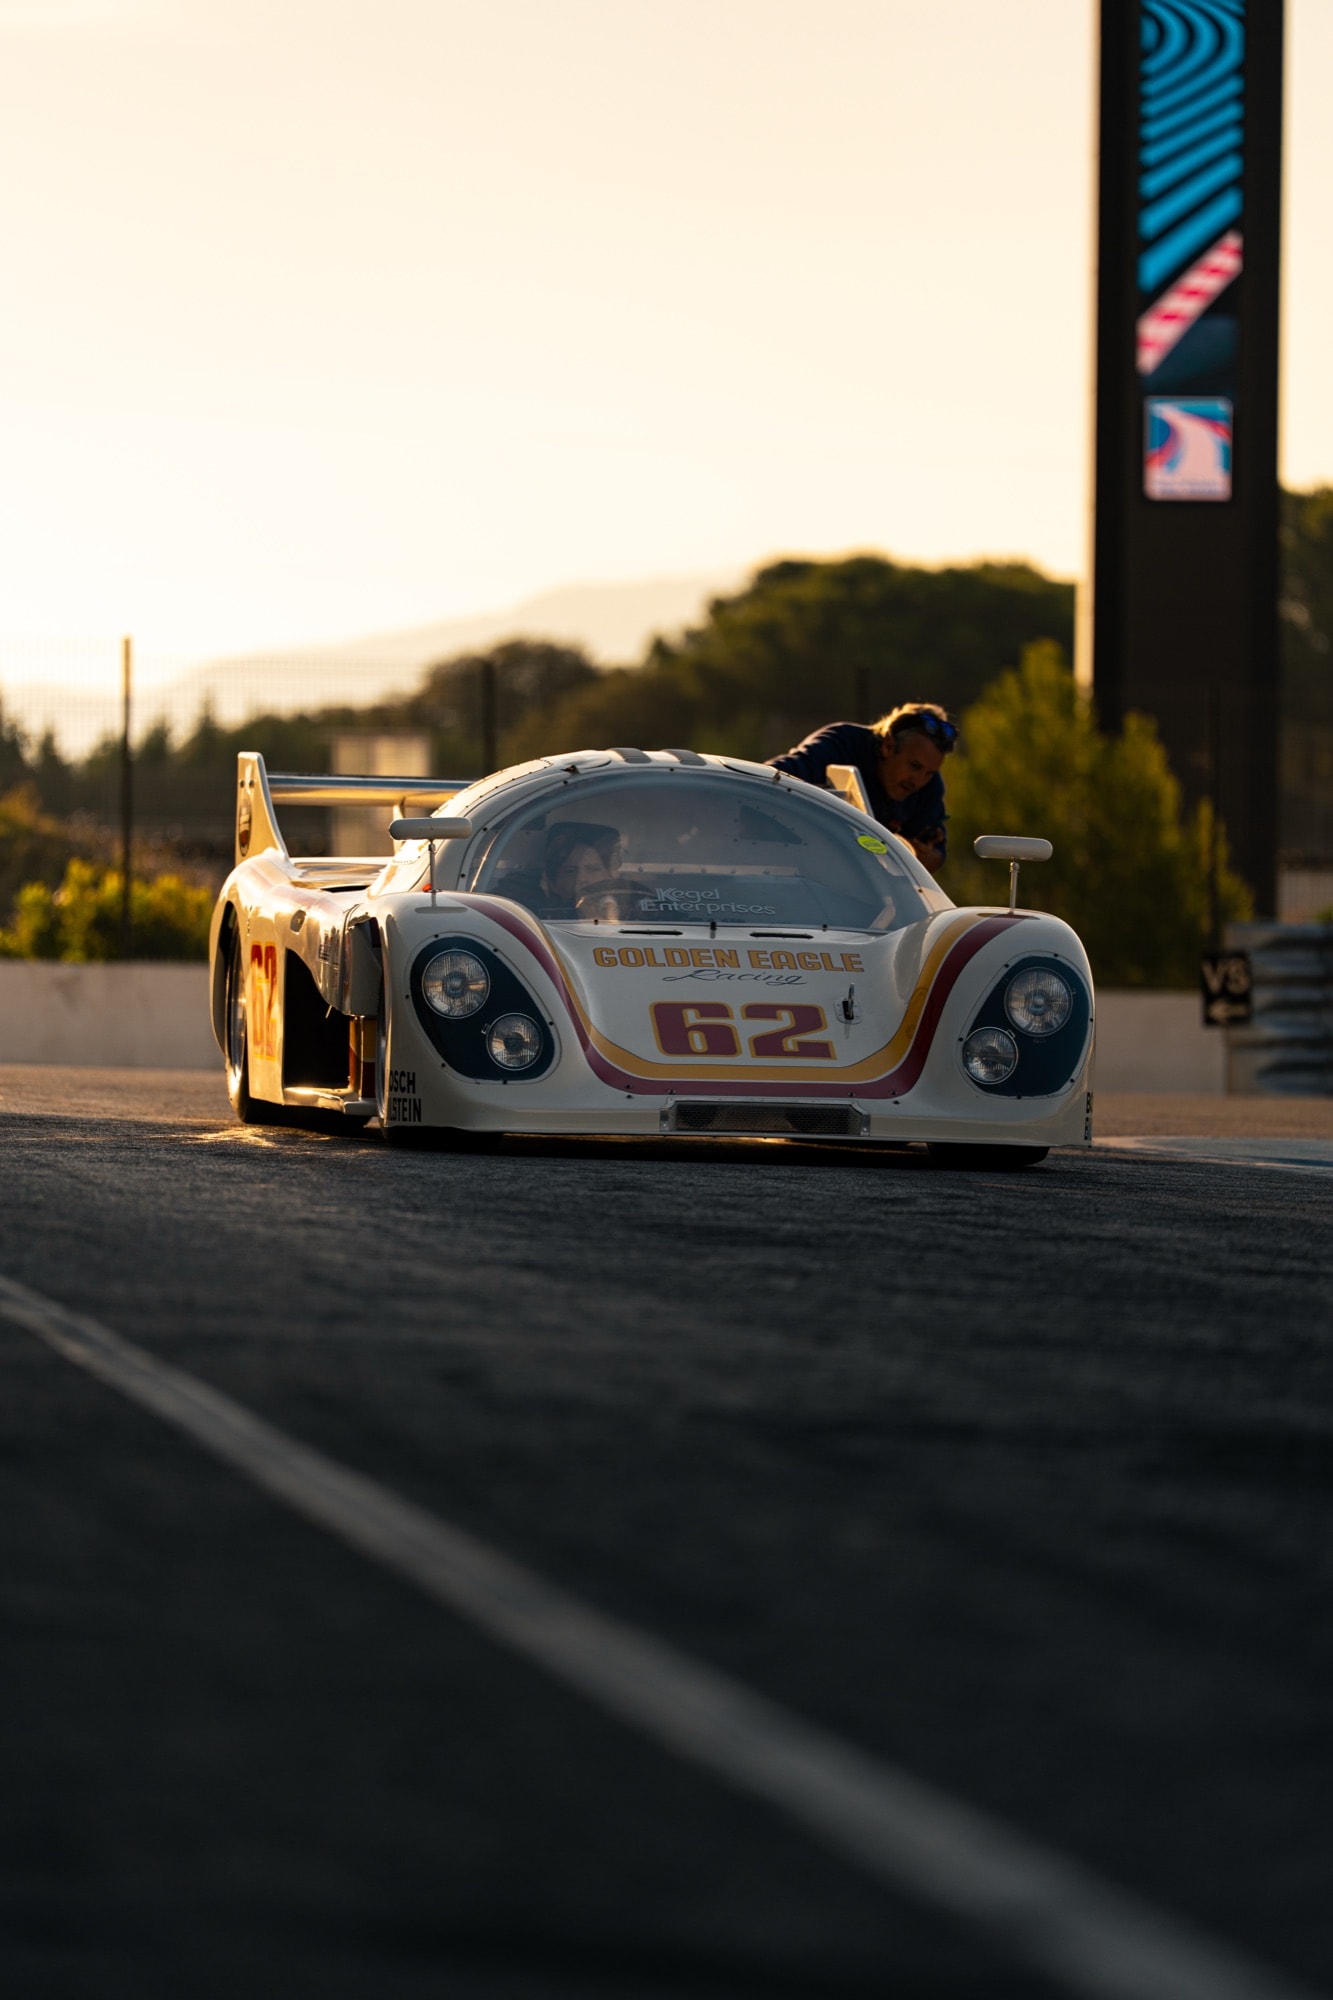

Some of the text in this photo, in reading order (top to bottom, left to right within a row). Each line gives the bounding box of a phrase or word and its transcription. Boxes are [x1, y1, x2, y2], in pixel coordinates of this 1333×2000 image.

[656, 888, 720, 903] Kegel
[640, 900, 776, 914] Enterprises
[592, 947, 865, 973] GOLDEN EAGLE
[662, 969, 807, 986] Racing
[649, 1001, 837, 1060] 62
